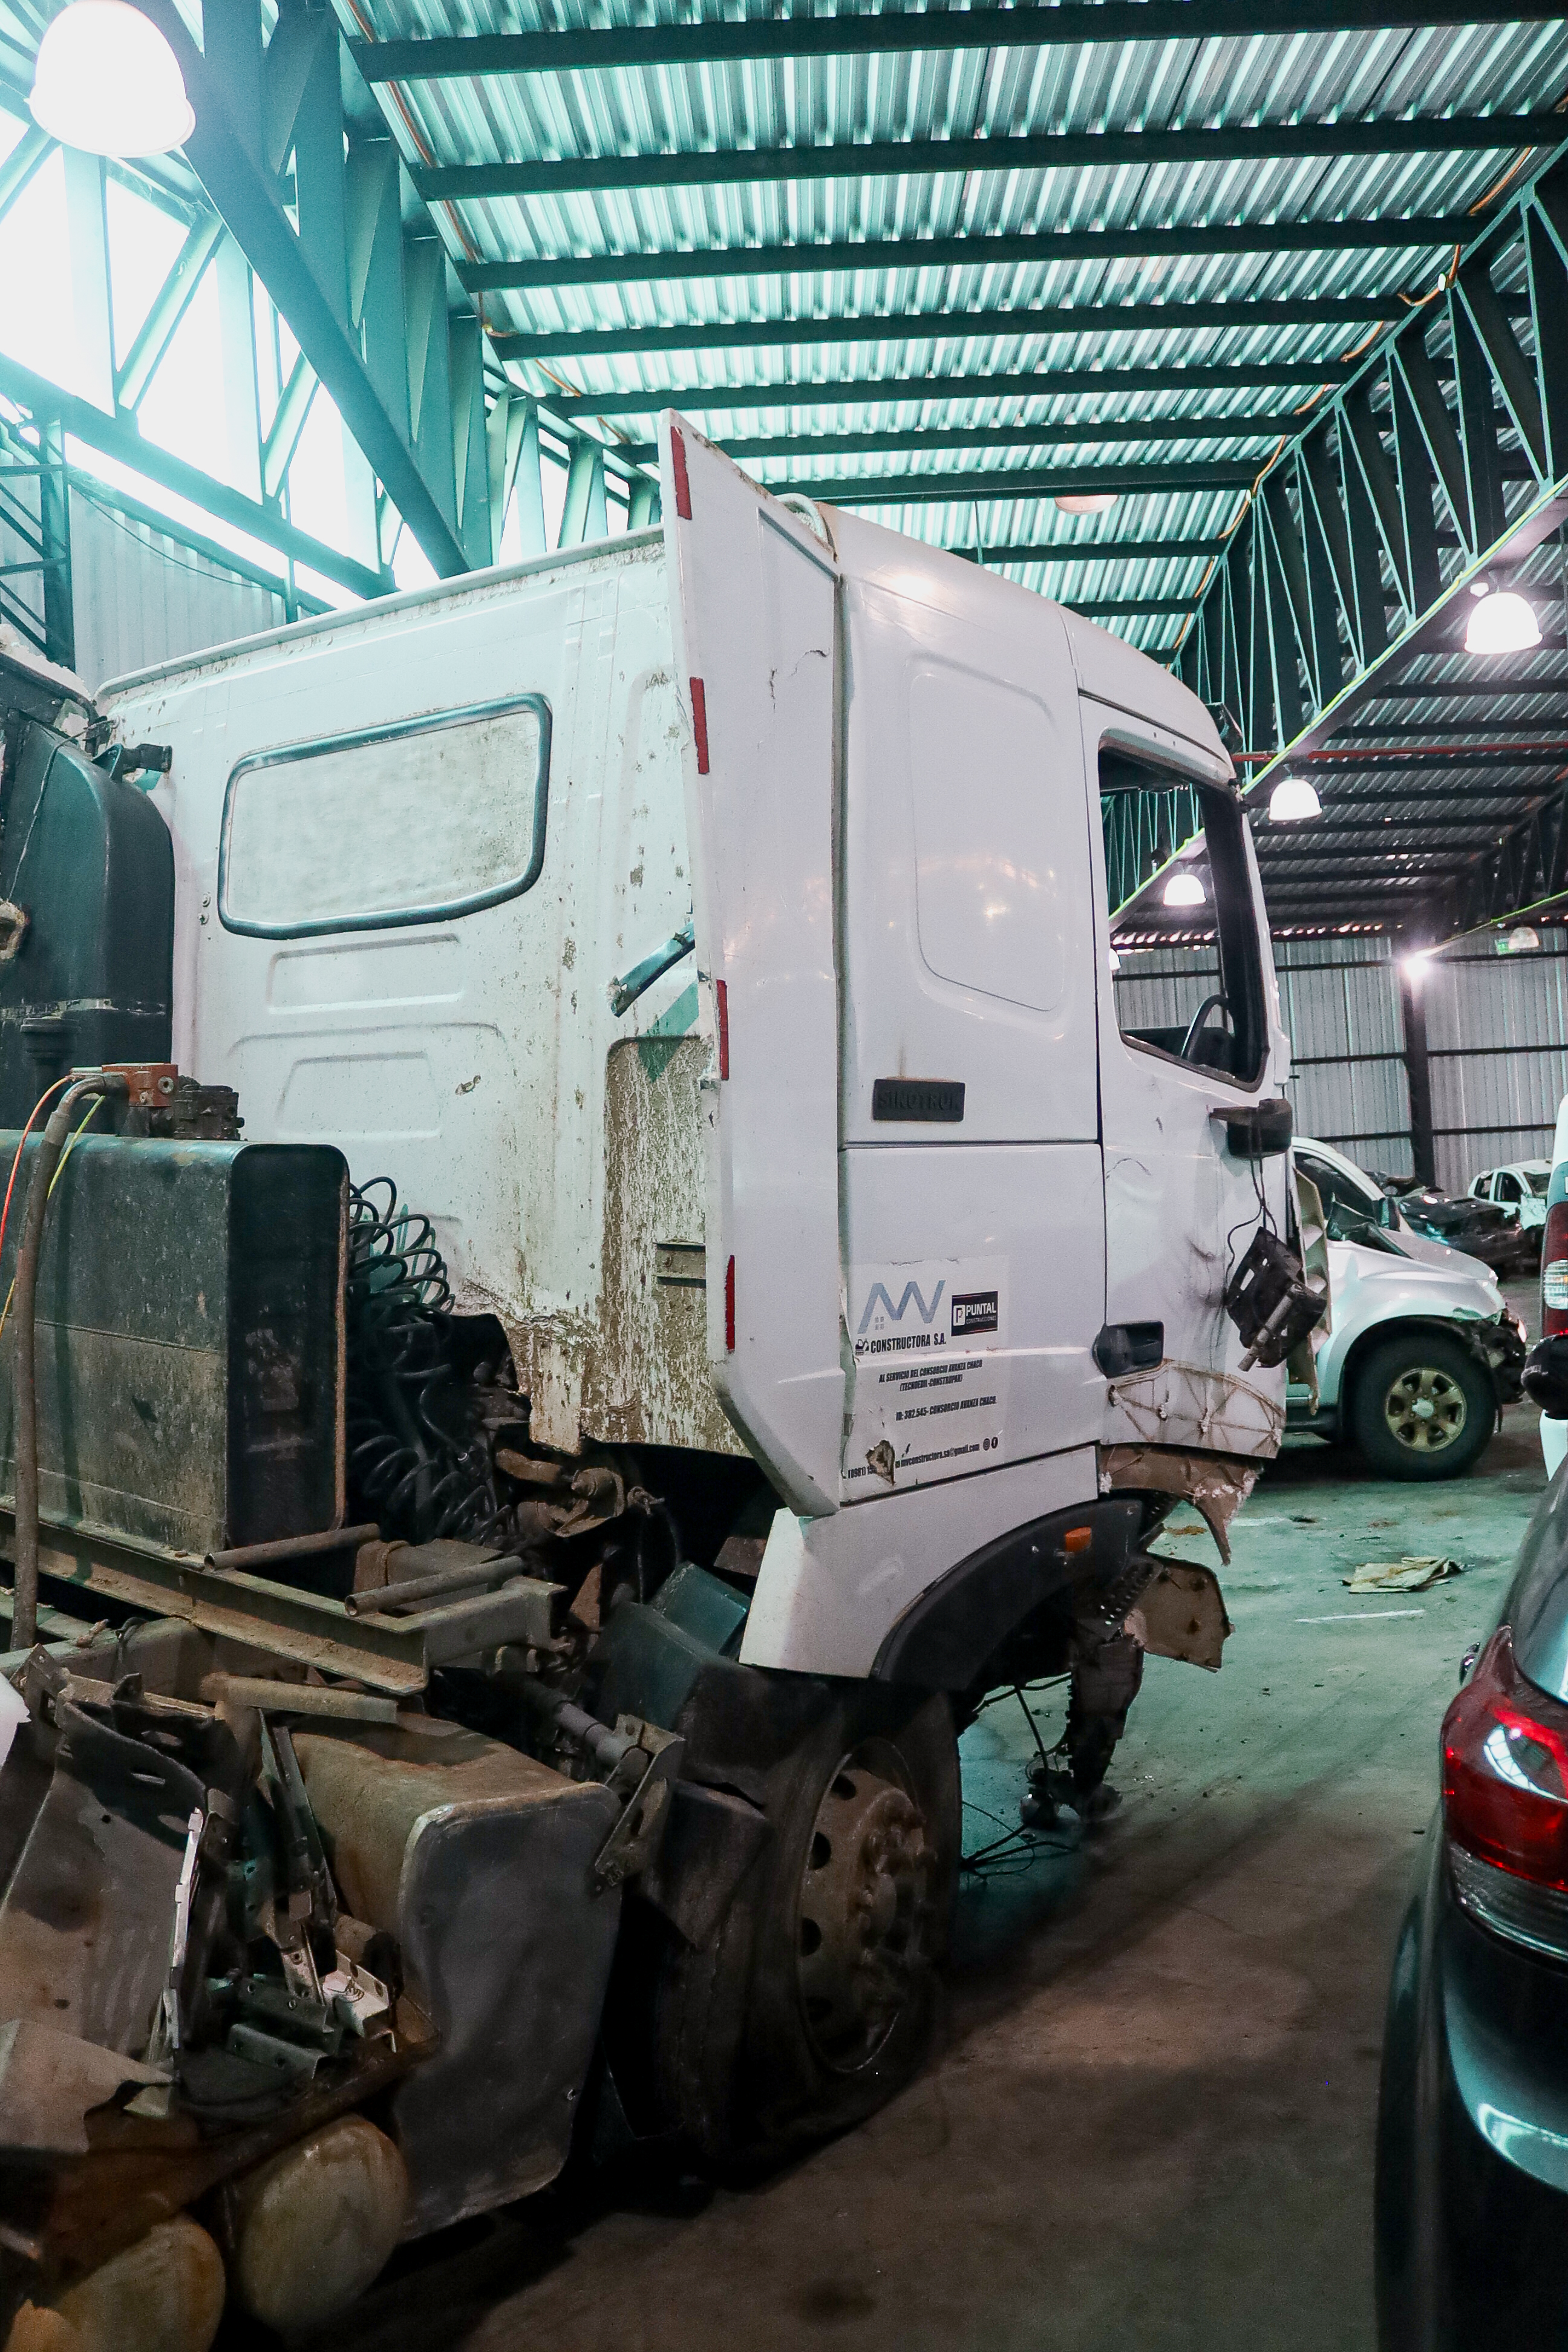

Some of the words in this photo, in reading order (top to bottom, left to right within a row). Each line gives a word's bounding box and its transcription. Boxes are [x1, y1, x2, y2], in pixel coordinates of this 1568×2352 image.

[966, 1302, 997, 1316] PUNTAL
[871, 1334, 931, 1354] CONSTRUCTORA
[933, 1333, 947, 1345] S.A.
[879, 1374, 886, 1383] AL
[886, 1370, 910, 1382] SERVICIO
[910, 1369, 919, 1378] DEL
[920, 1364, 948, 1377] CONSORCIO
[949, 1362, 966, 1373] AVANZA
[967, 1359, 983, 1370] CHACO
[930, 1401, 959, 1415] CONSORCIO
[960, 1398, 979, 1410] AVANZA
